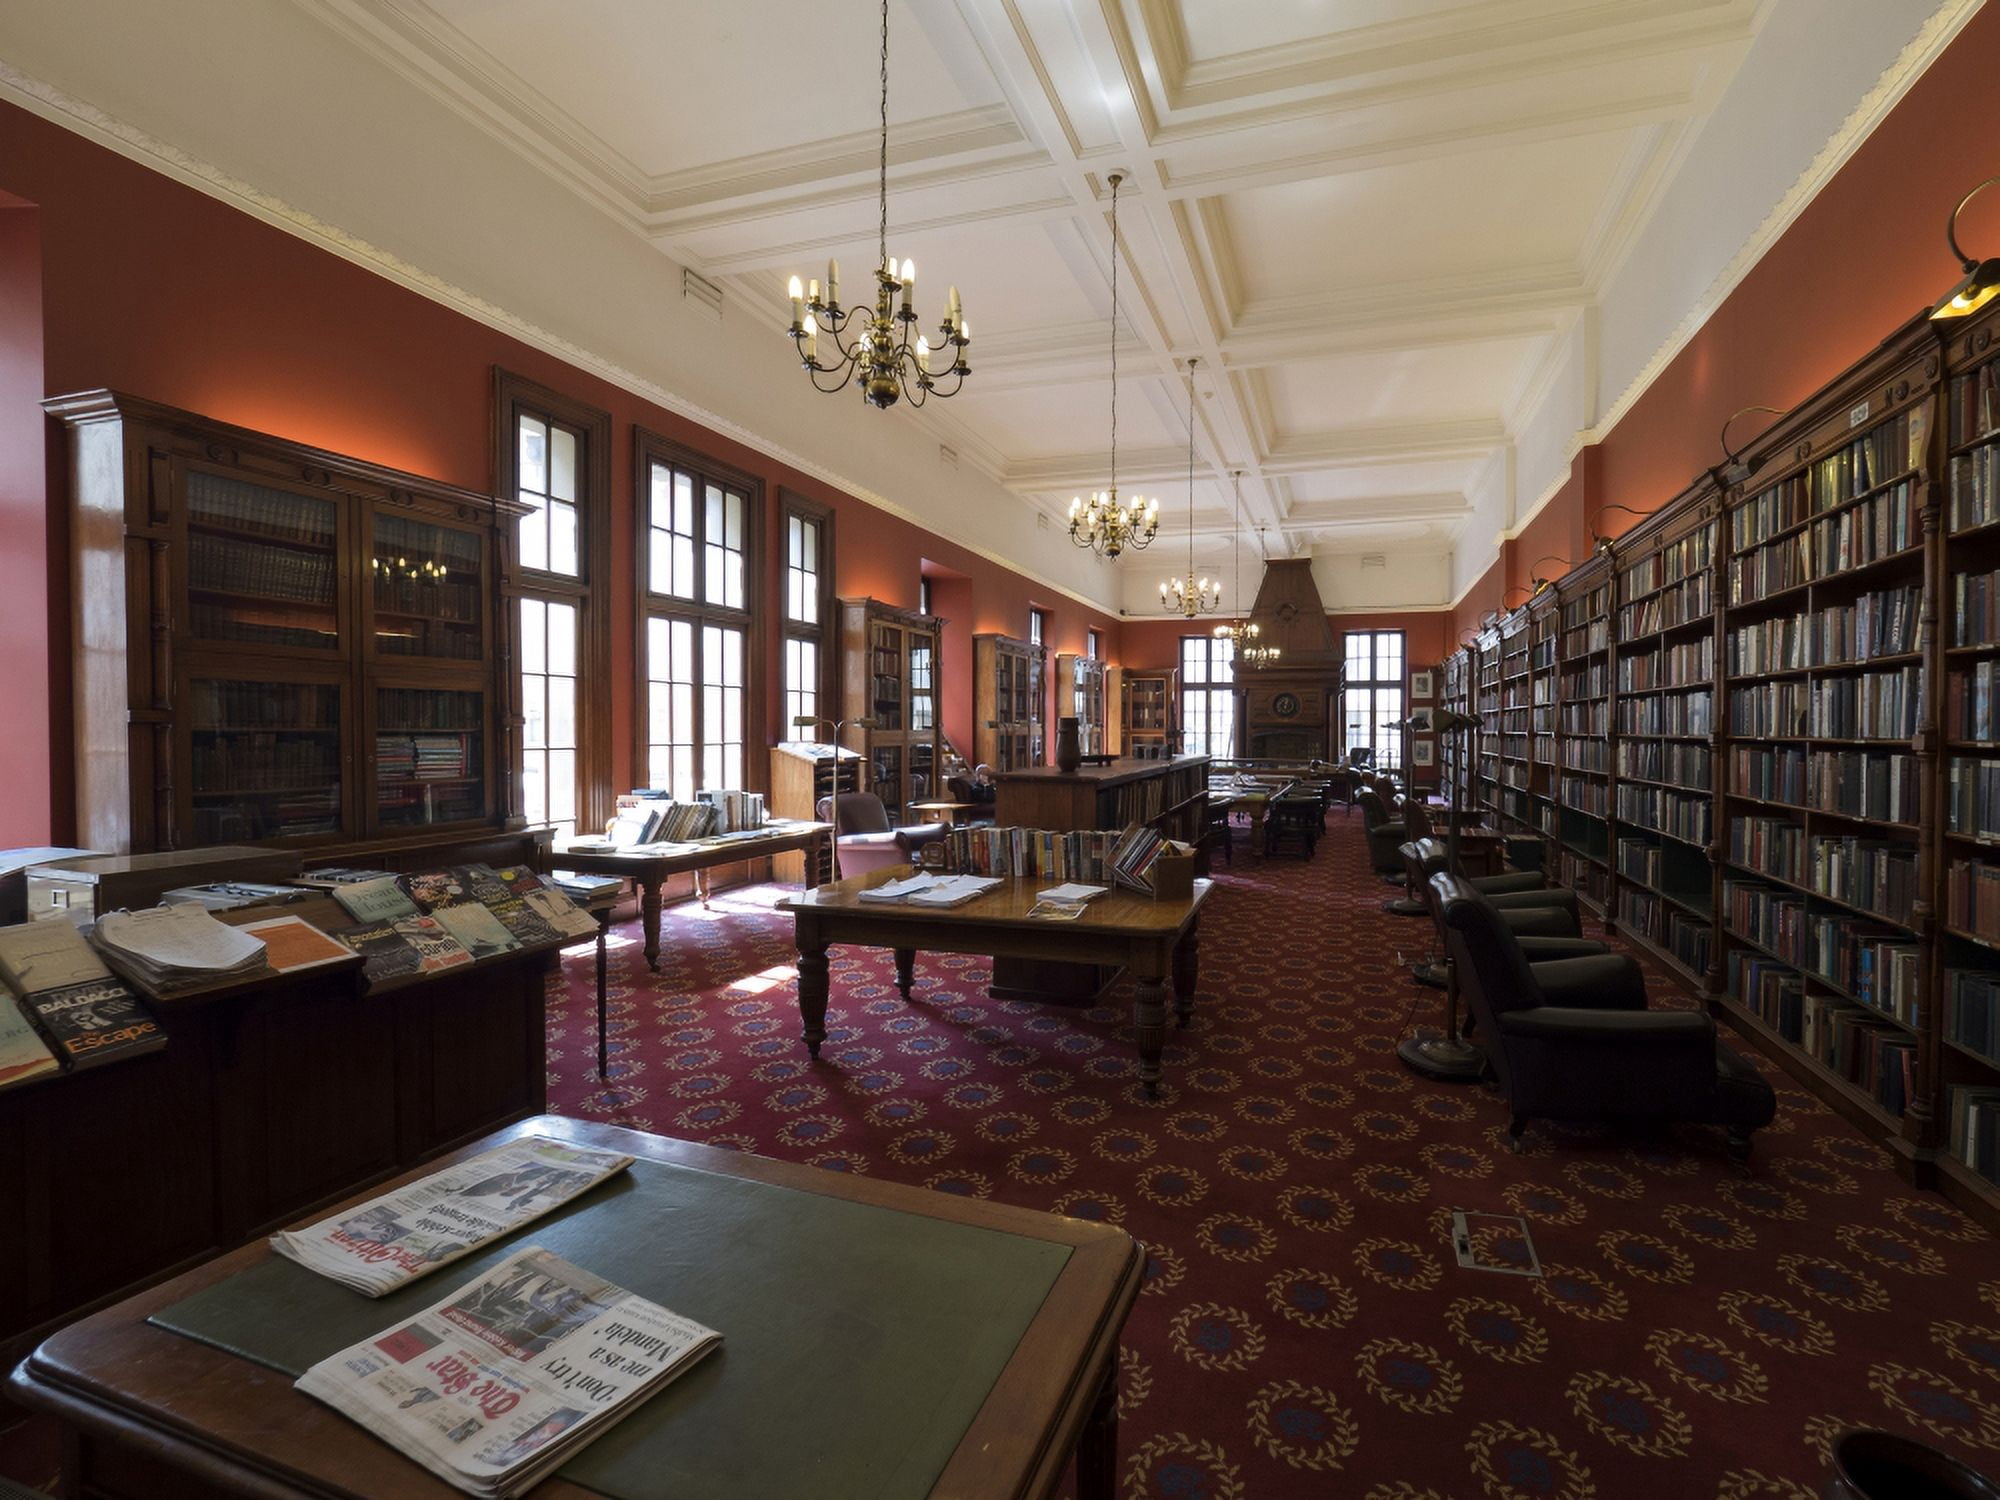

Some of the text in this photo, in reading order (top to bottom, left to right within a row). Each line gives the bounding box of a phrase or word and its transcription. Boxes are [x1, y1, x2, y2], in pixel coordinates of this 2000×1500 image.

[64, 1022, 157, 1053] Escape
[426, 1354, 475, 1395] Star
[540, 1356, 573, 1380] try
[588, 1346, 653, 1378] me as a
[470, 1377, 521, 1420] The
